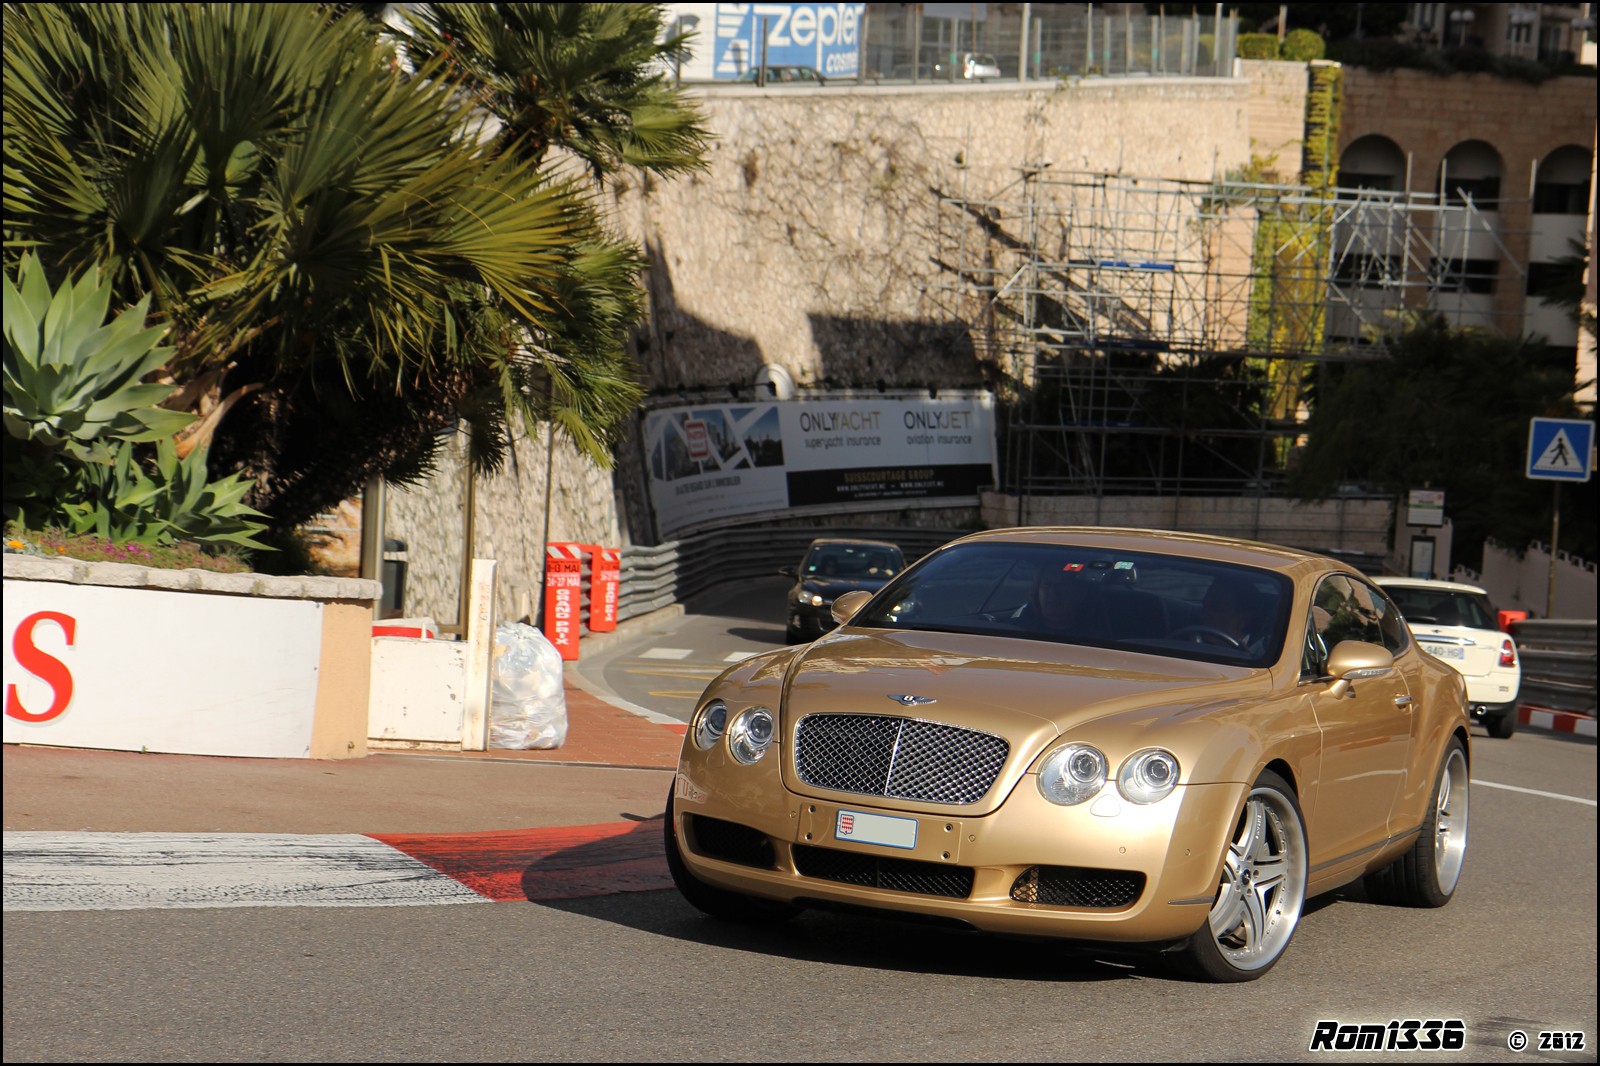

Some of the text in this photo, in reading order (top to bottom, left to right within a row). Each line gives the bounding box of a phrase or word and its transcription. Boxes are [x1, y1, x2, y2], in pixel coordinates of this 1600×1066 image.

[800, 411, 881, 432] ONLYYACHT
[903, 410, 972, 430] ONLYJET
[804, 435, 881, 449] superyacht insurance
[906, 434, 972, 445] aviation insurance
[908, 469, 934, 480] GROUP
[555, 589, 570, 618] GRAND
[555, 621, 569, 645] PRIX
[4, 610, 77, 724] S
